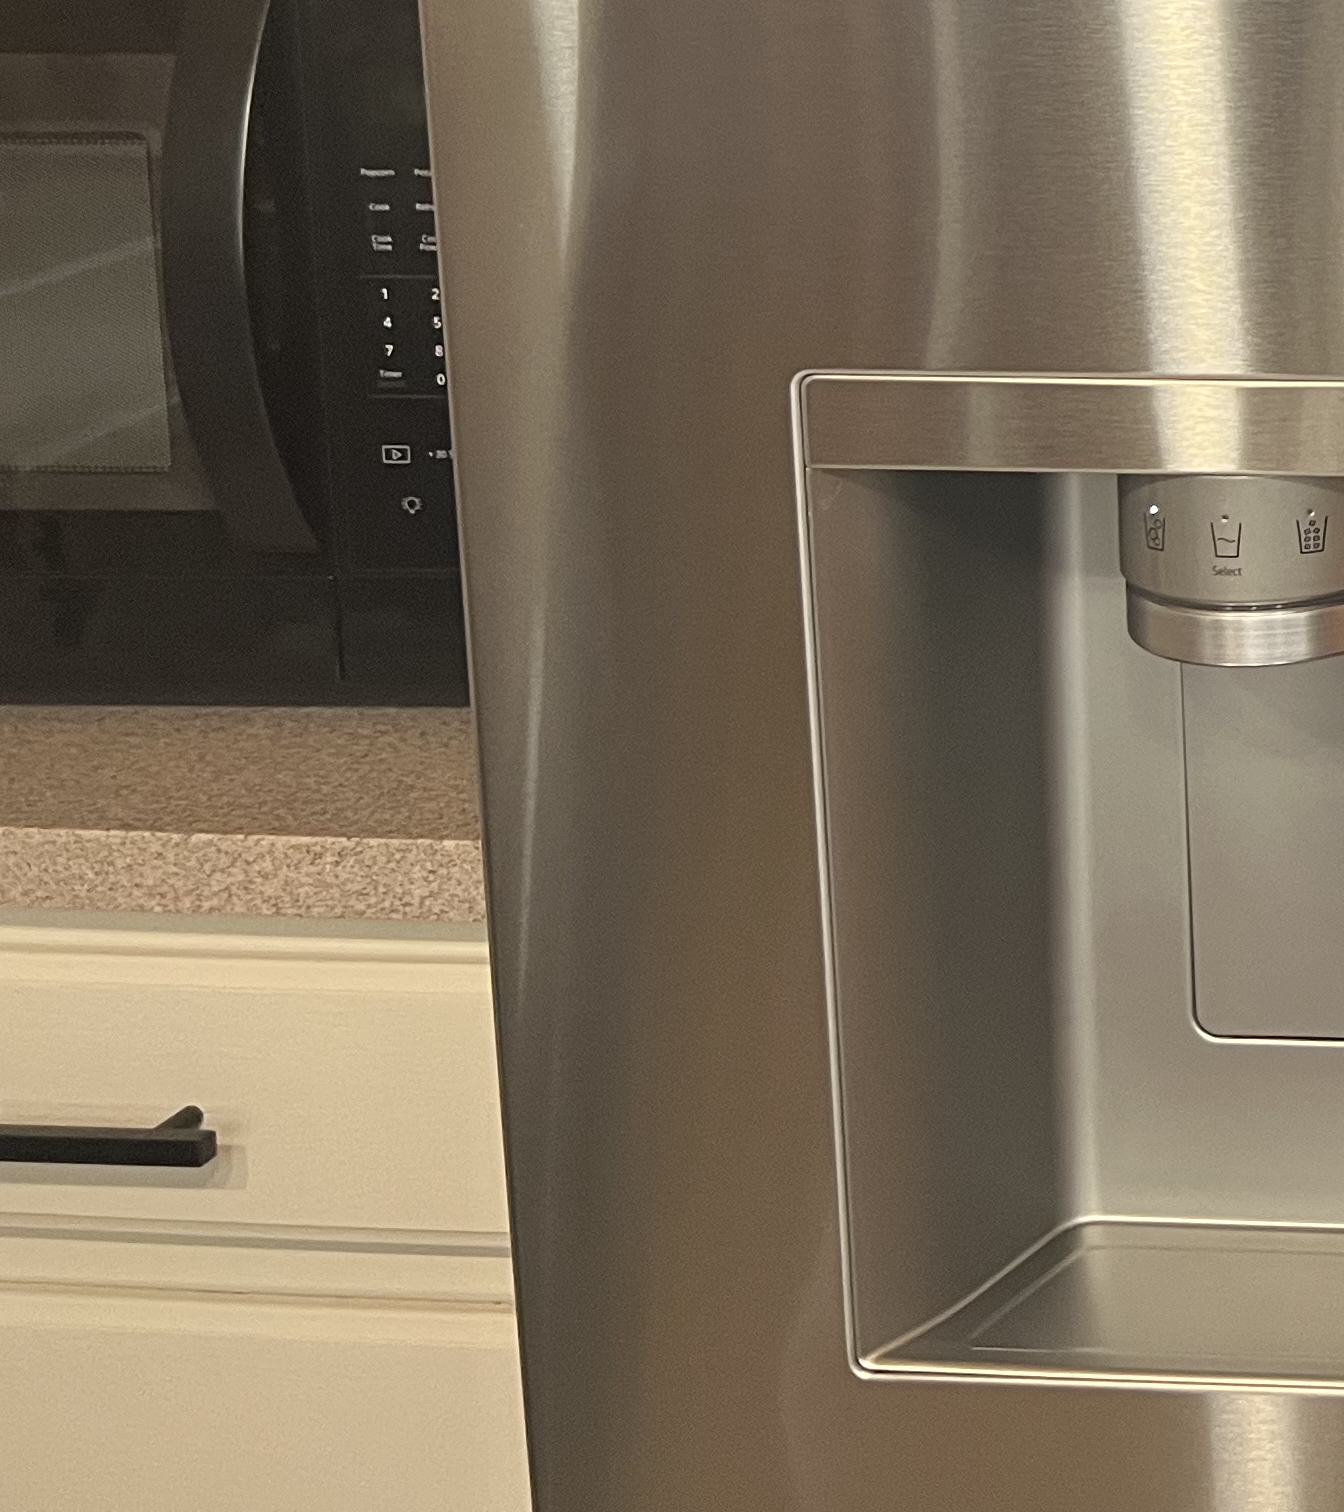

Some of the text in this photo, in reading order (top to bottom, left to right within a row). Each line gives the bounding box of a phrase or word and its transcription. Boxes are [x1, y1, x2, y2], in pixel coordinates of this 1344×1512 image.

[381, 287, 440, 300] 1 2
[383, 315, 442, 329] 4 5
[384, 344, 444, 357] 7 8
[436, 373, 446, 386] 0
[1212, 565, 1242, 577] Select
